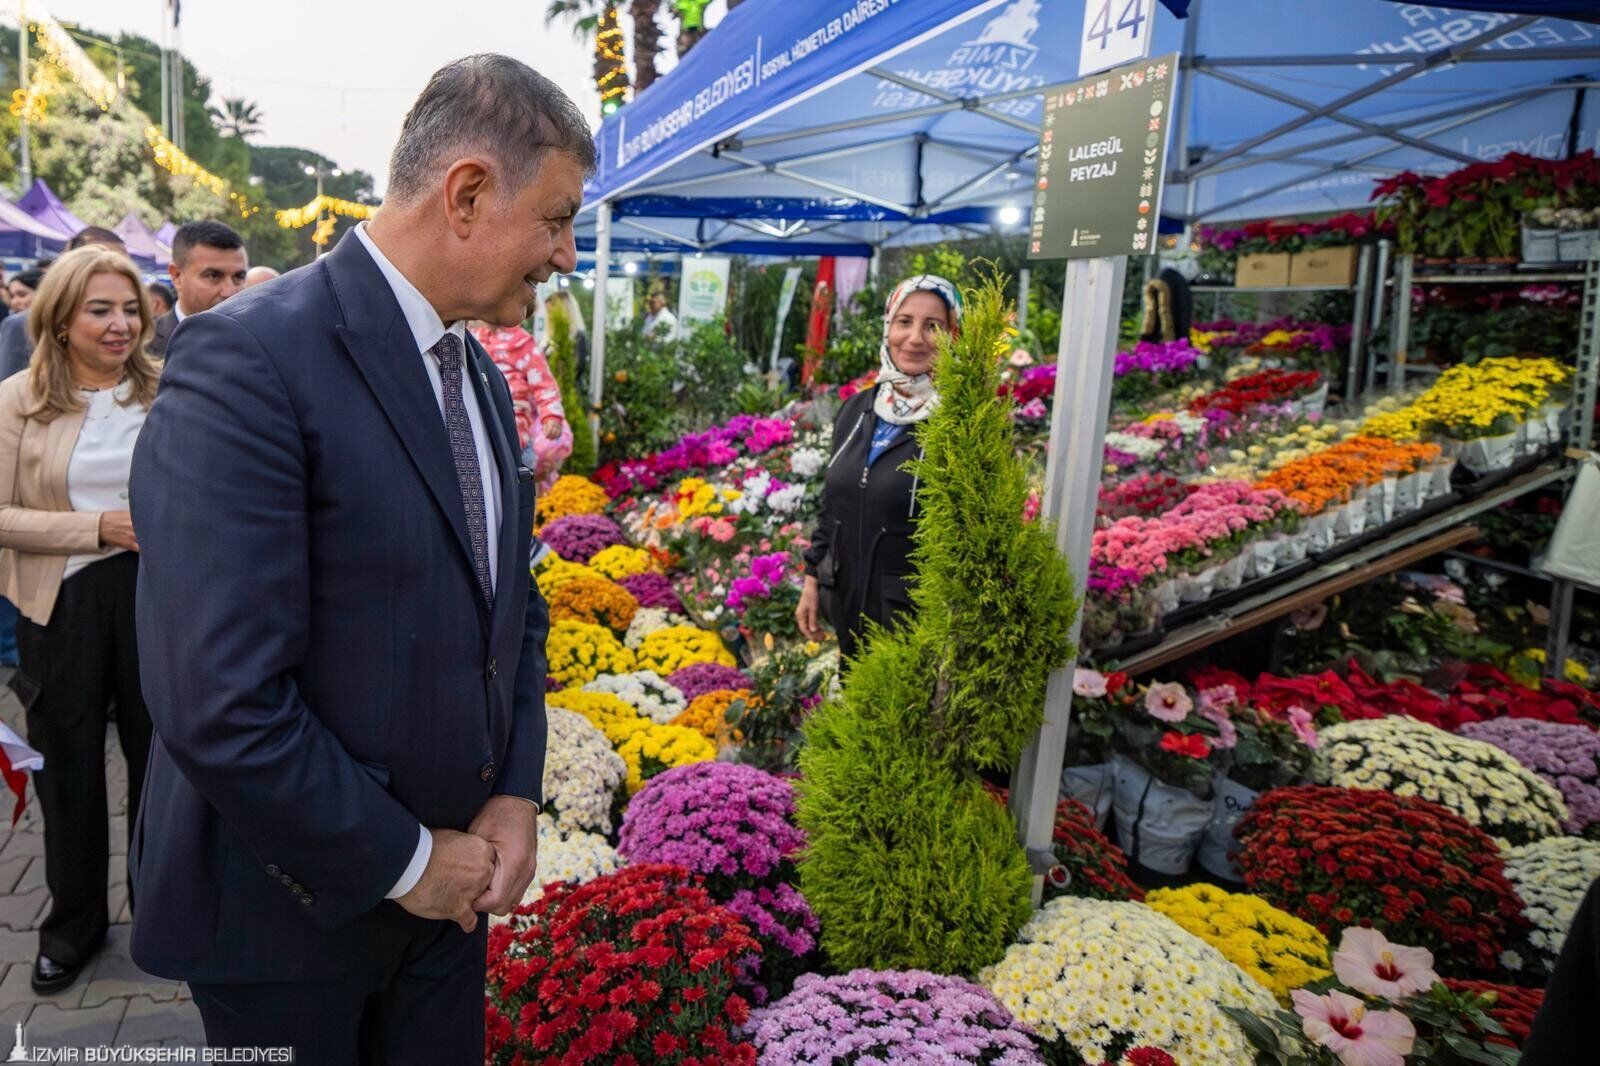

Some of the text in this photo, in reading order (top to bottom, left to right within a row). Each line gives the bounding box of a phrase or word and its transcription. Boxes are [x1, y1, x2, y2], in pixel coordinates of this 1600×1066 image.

[761, 50, 793, 80] SOSYAL
[791, 18, 844, 62] HİZMETLER
[1087, 0, 1145, 49] 44
[693, 55, 754, 119] BELEDİYESİ
[1069, 136, 1123, 162] LALEGÜL
[1070, 161, 1117, 182] PEYZAJ
